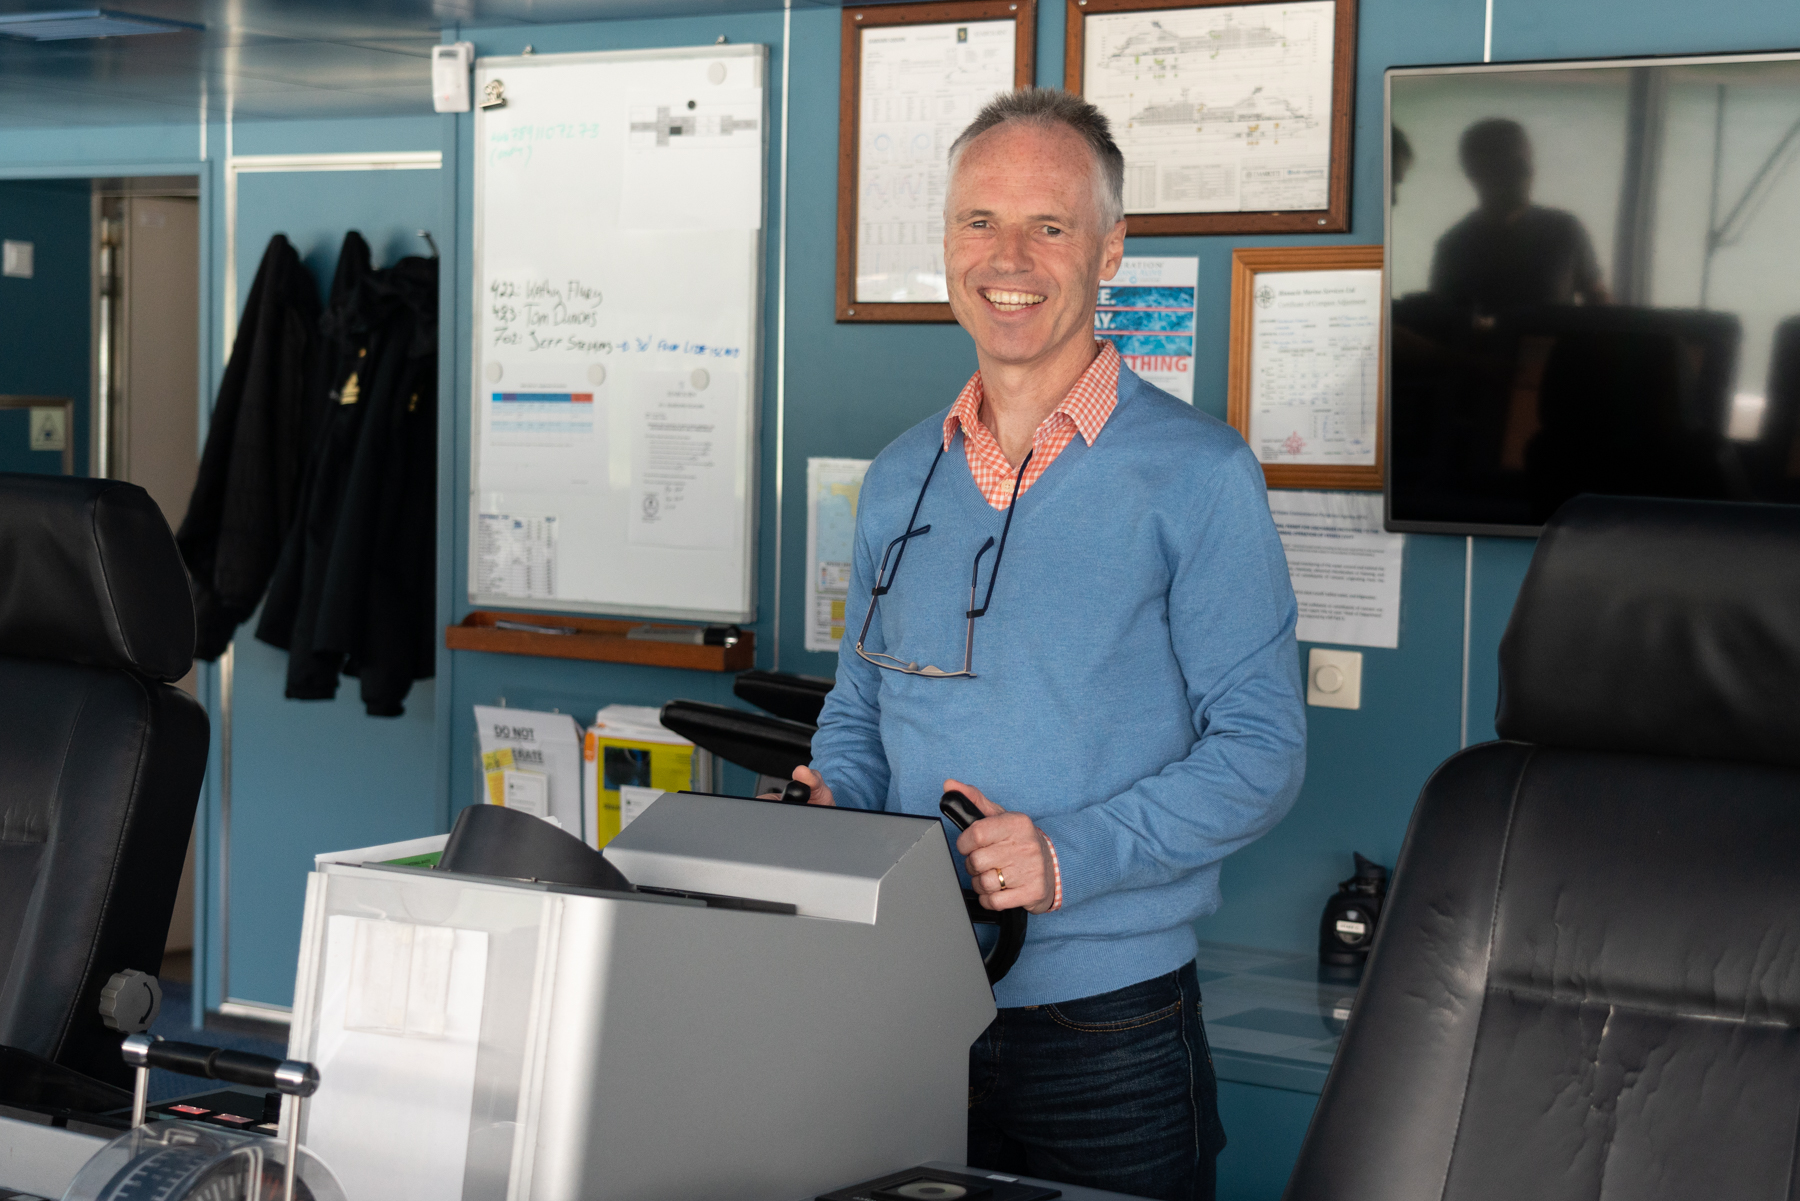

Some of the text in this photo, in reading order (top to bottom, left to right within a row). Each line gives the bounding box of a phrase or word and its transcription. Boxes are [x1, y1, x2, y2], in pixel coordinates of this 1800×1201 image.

[1097, 288, 1117, 305] E.
[494, 724, 534, 740] DO NOT
[512, 748, 543, 762] ERATE
